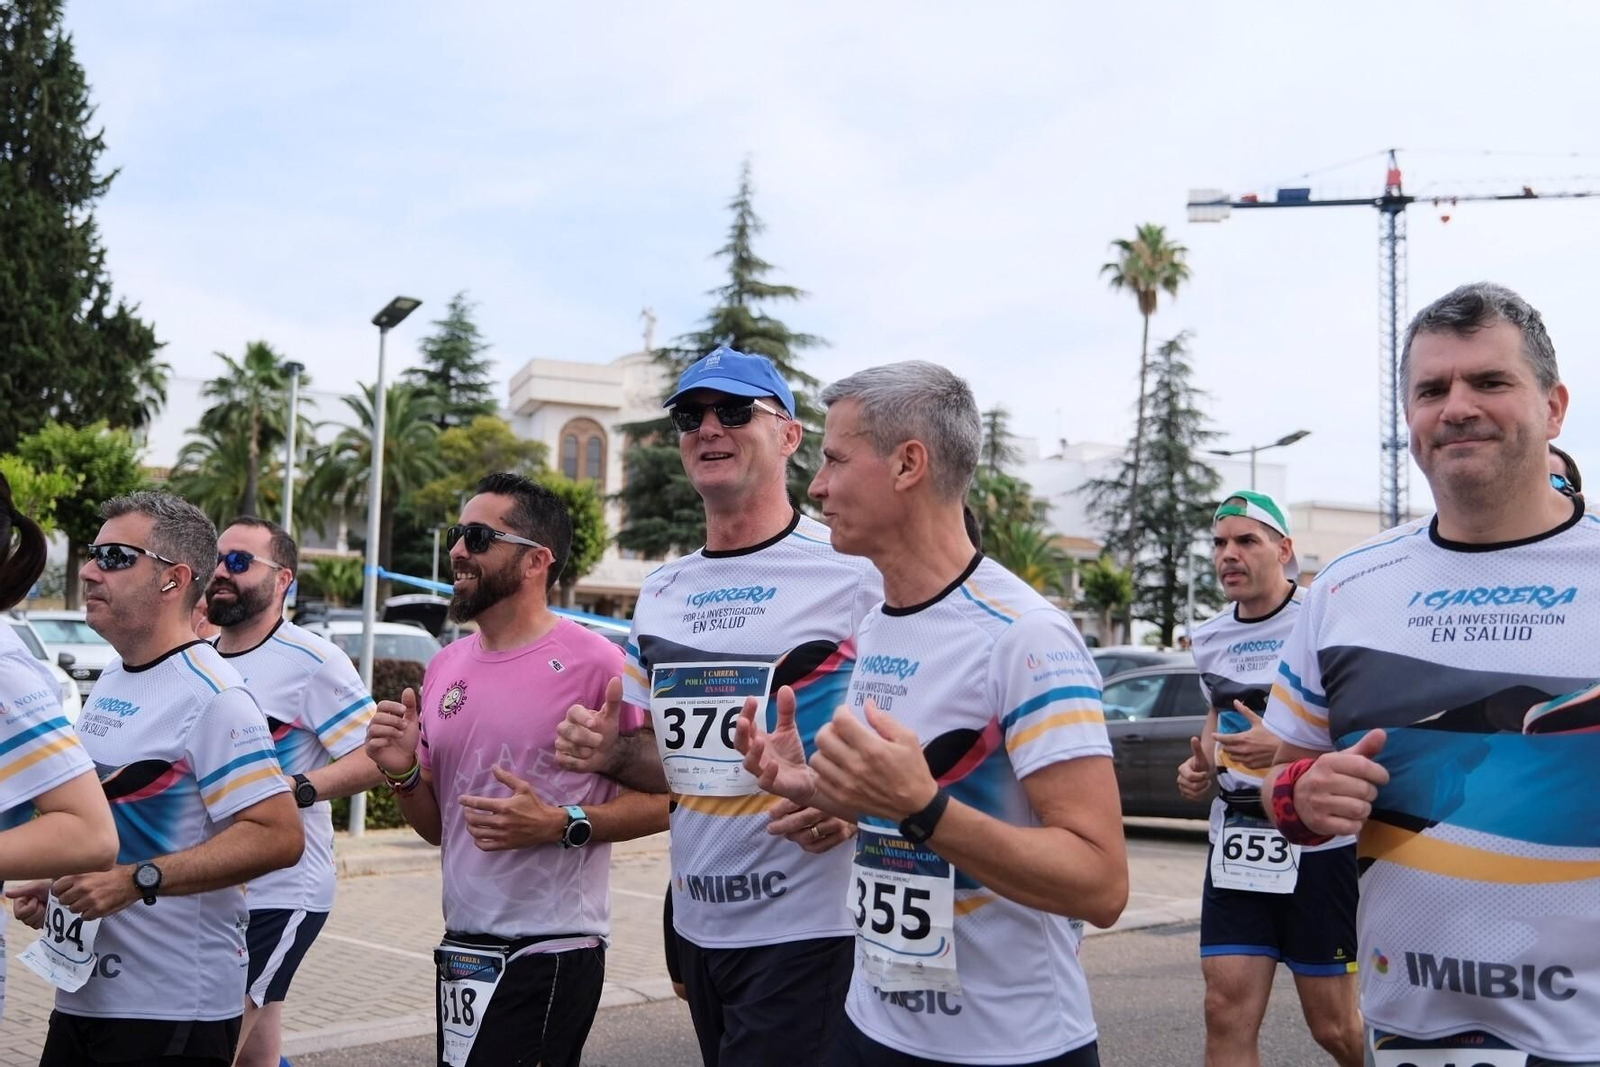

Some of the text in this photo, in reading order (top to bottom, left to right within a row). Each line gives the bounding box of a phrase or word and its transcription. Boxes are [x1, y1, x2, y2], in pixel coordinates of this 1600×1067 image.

[692, 585, 778, 609] CARRERA
[1424, 585, 1578, 611] CARRERA
[683, 606, 767, 623] POR LA INVESTIGACIÓN
[1408, 612, 1566, 628] POR LA INVESTIGACIÓN
[693, 616, 746, 634] EN SALUD
[1431, 626, 1533, 643] EN SALUD
[1232, 639, 1285, 655] CARRERA
[708, 669, 739, 678] CARRERA
[861, 655, 920, 681] CARRERA
[1235, 663, 1245, 673] EN
[684, 678, 698, 686] POR
[664, 706, 744, 750] 376
[1223, 833, 1289, 864] 653
[686, 870, 788, 903] IMIBIC
[1405, 951, 1578, 1002] IMIBIC
